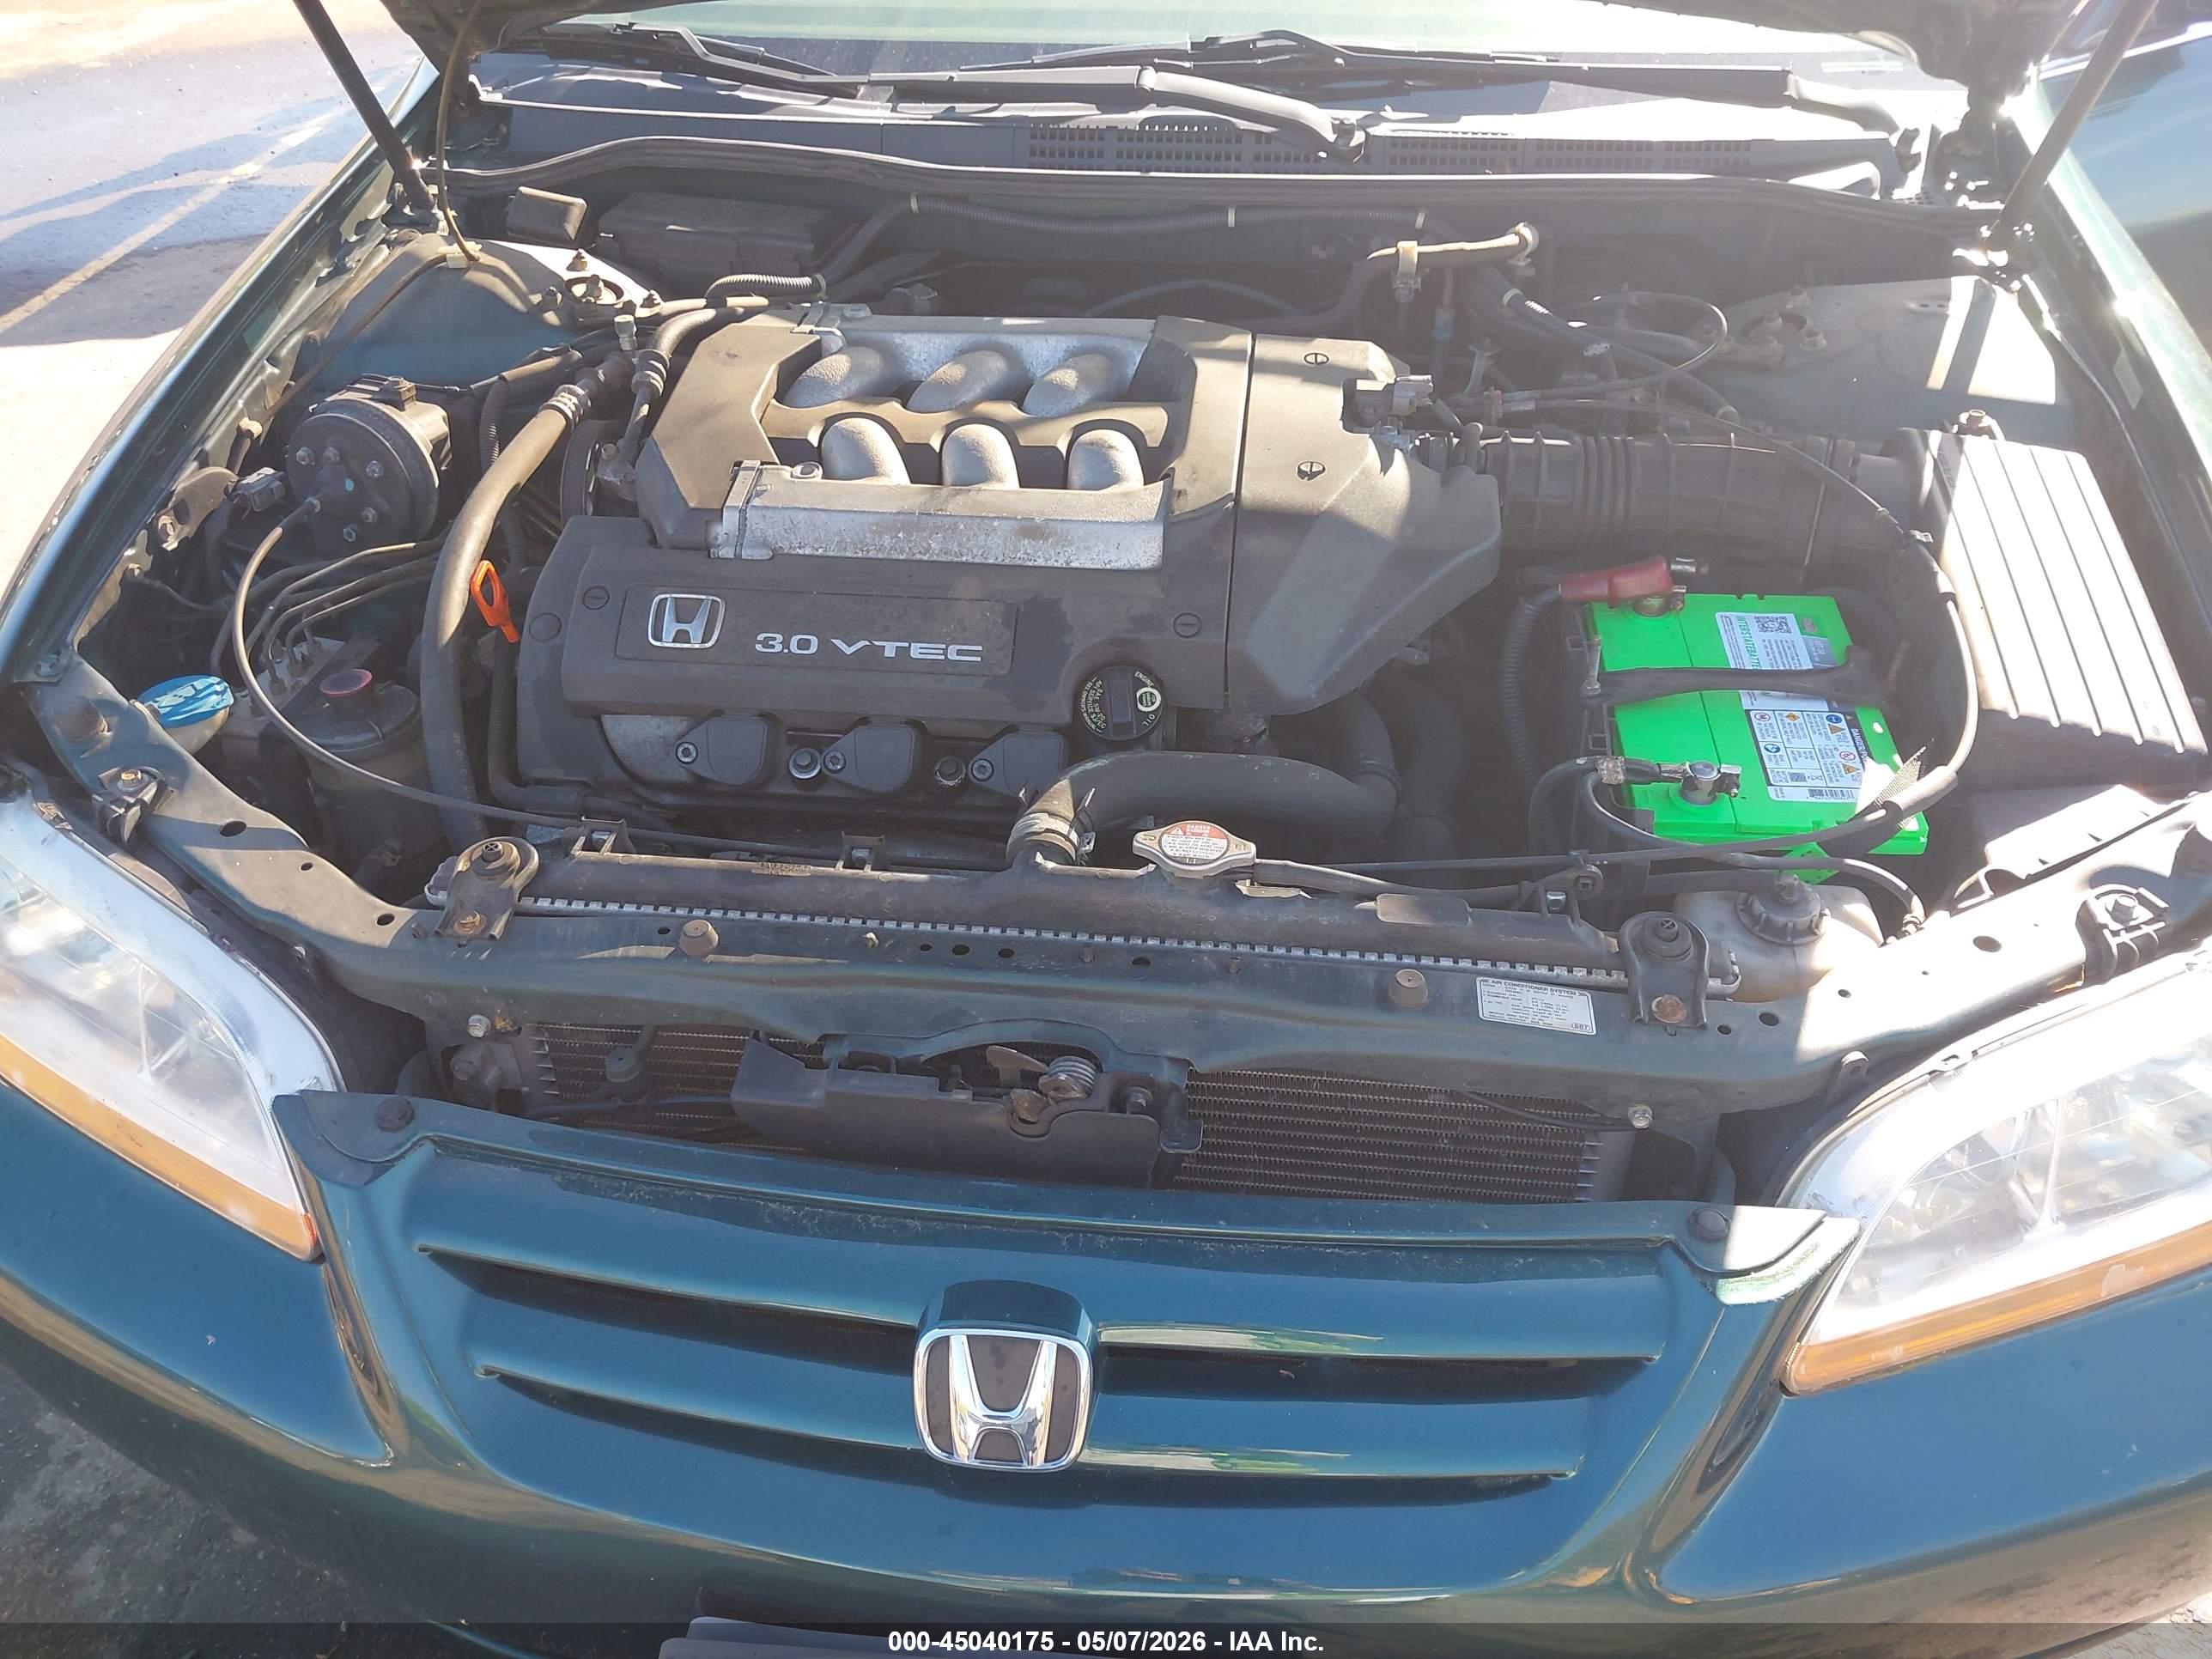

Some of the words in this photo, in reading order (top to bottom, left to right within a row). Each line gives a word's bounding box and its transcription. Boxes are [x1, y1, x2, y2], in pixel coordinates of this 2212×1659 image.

[755, 633, 818, 655] 3.0
[830, 638, 982, 662] VTEC
[1134, 671, 1154, 688] ENGINE
[1085, 689, 1096, 714] SERVICE
[1093, 689, 1103, 700] SAE
[1142, 714, 1155, 726] OIL
[1504, 981, 1548, 992] CONDITIONER
[1549, 988, 1577, 996] SYSTEM
